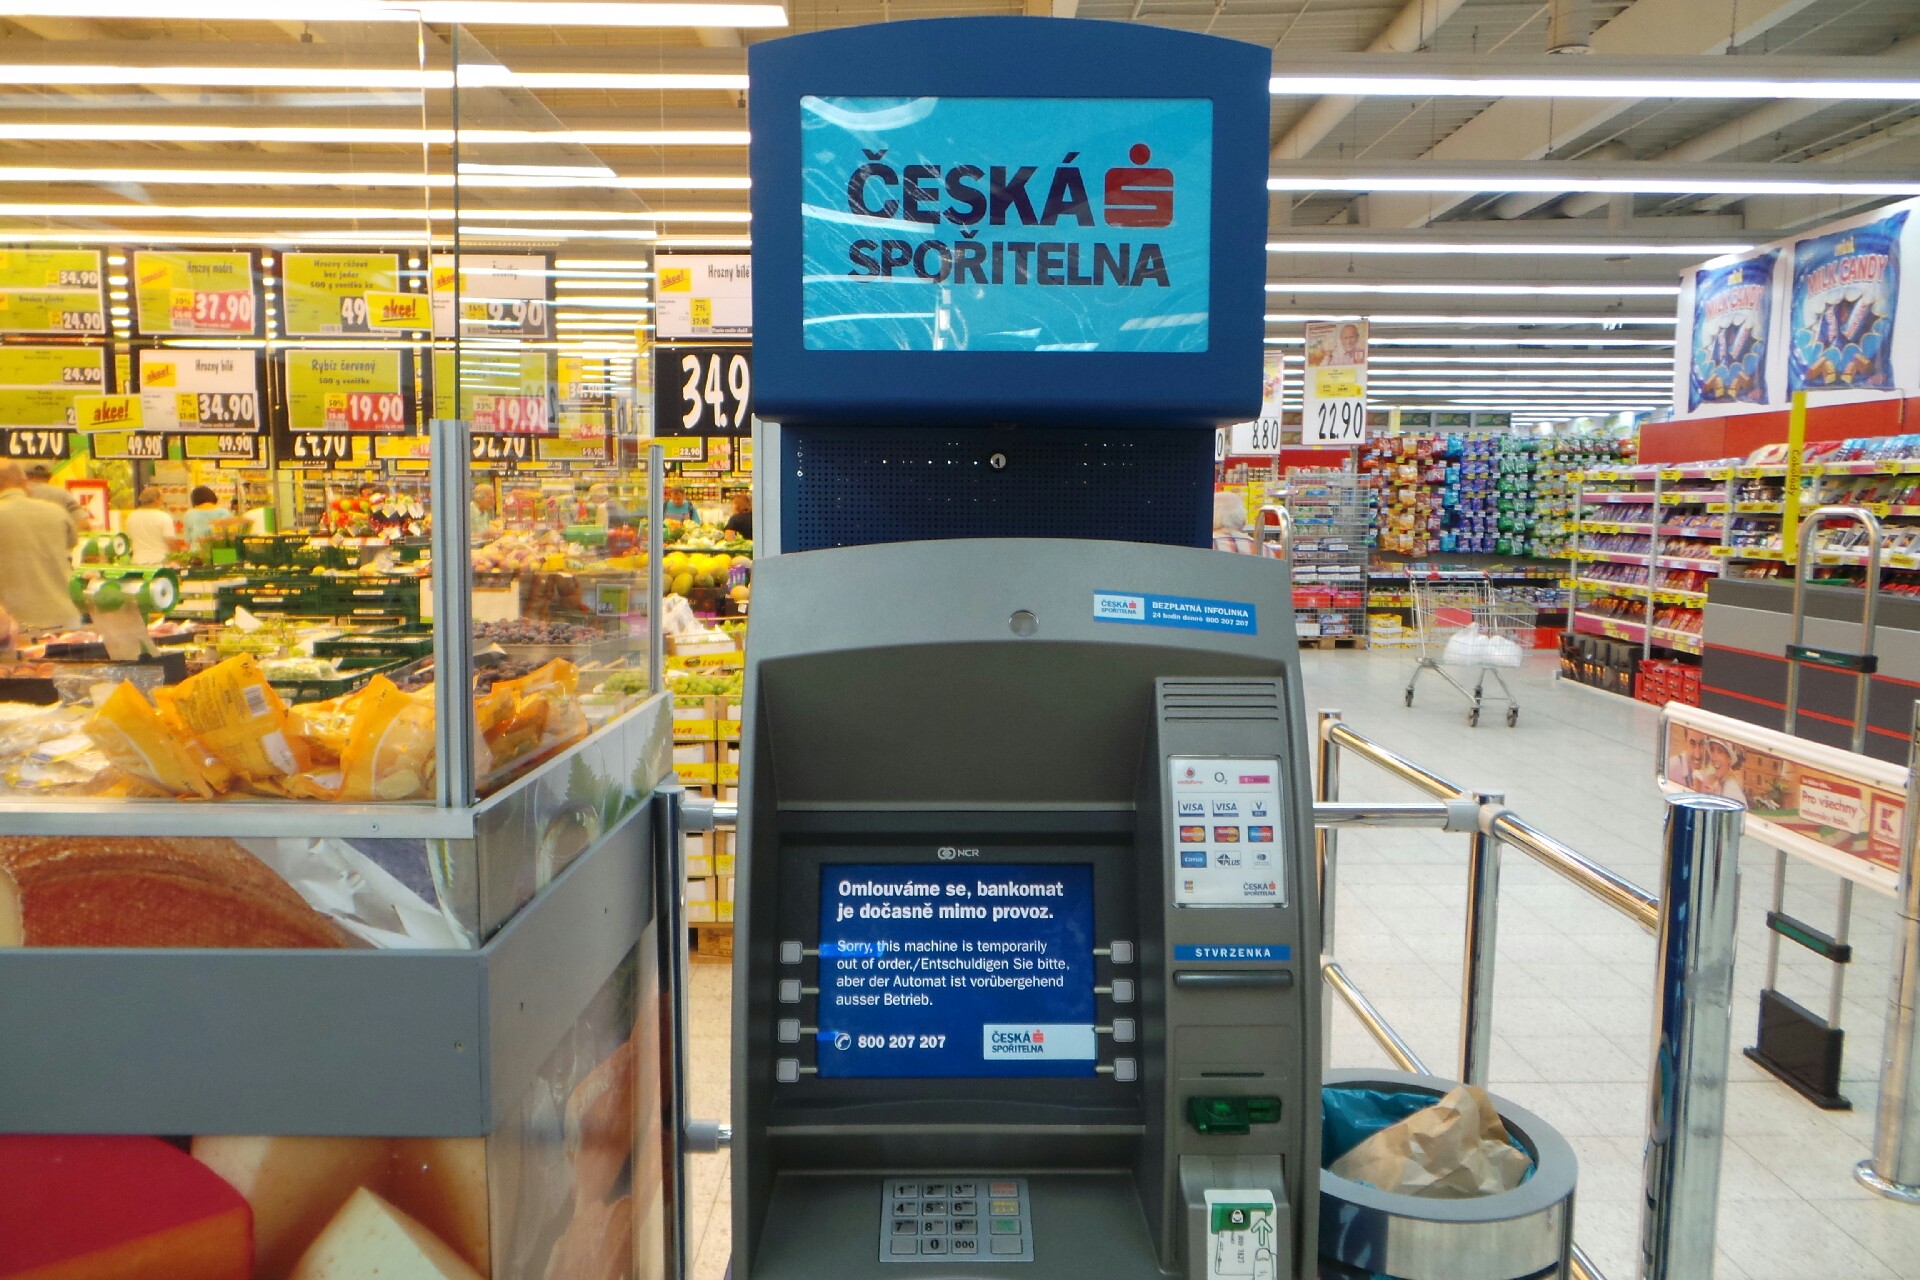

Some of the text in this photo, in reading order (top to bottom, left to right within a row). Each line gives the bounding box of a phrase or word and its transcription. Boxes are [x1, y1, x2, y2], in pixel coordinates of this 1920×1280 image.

[848, 149, 1095, 227] ČESKÁ
[848, 230, 1171, 287] SPOŘITELNA
[60, 270, 98, 284] 34.90
[708, 265, 750, 281] Hrozny bílé
[1808, 253, 1889, 298] MILK CANDY
[195, 293, 252, 321] 37.90
[382, 298, 416, 318] akce!
[1705, 284, 1764, 320] MILK CANDY
[63, 312, 101, 329] 24.90
[63, 367, 101, 381] 24.90
[195, 360, 233, 374] Hrozny bílé
[311, 359, 375, 374] Rybíz červený
[682, 354, 750, 429] 34.9
[94, 400, 129, 421] akce!
[199, 394, 253, 421] 34.90
[349, 394, 403, 423] 19.90
[1319, 401, 1363, 440] 22.90
[1252, 419, 1279, 449] 8.80
[127, 435, 160, 456] 49.90
[219, 434, 251, 452] 49.90
[680, 448, 700, 456] 22.90
[1101, 600, 1129, 608] ČESKÁ
[1152, 601, 1249, 617] BEZPLATNÁ INFOLINKA
[1163, 612, 1181, 620] hodin
[1802, 790, 1816, 805] Pro
[1182, 803, 1204, 812] VISA
[1216, 803, 1237, 811] VISA
[1881, 808, 1895, 833] K
[957, 848, 980, 858] NCR
[1223, 859, 1241, 867] PLUS
[838, 880, 1064, 899] Omlouváme se, bankomat
[1243, 881, 1268, 891] ČESKÁ
[837, 903, 1054, 922] je dočasně mimo provoz.
[837, 940, 1047, 954] Sorry, this machine is temporarily
[1195, 947, 1271, 958] STVRZENKA
[837, 958, 1070, 973] out of order./Entschuldigen Sie bitte,
[836, 976, 1064, 991] aber der Automat ist vorübergehend
[836, 993, 933, 1006] ausser Betrieb.
[858, 1036, 946, 1049] 800 207 207
[992, 1031, 1031, 1043] ČESKÁ
[992, 1044, 1044, 1053] SPOŘITELNA
[898, 1185, 963, 1195] 1 2 3
[896, 1202, 962, 1213] 4 5 6
[895, 1222, 963, 1232] 7 8 9
[930, 1239, 975, 1249] 0 000
